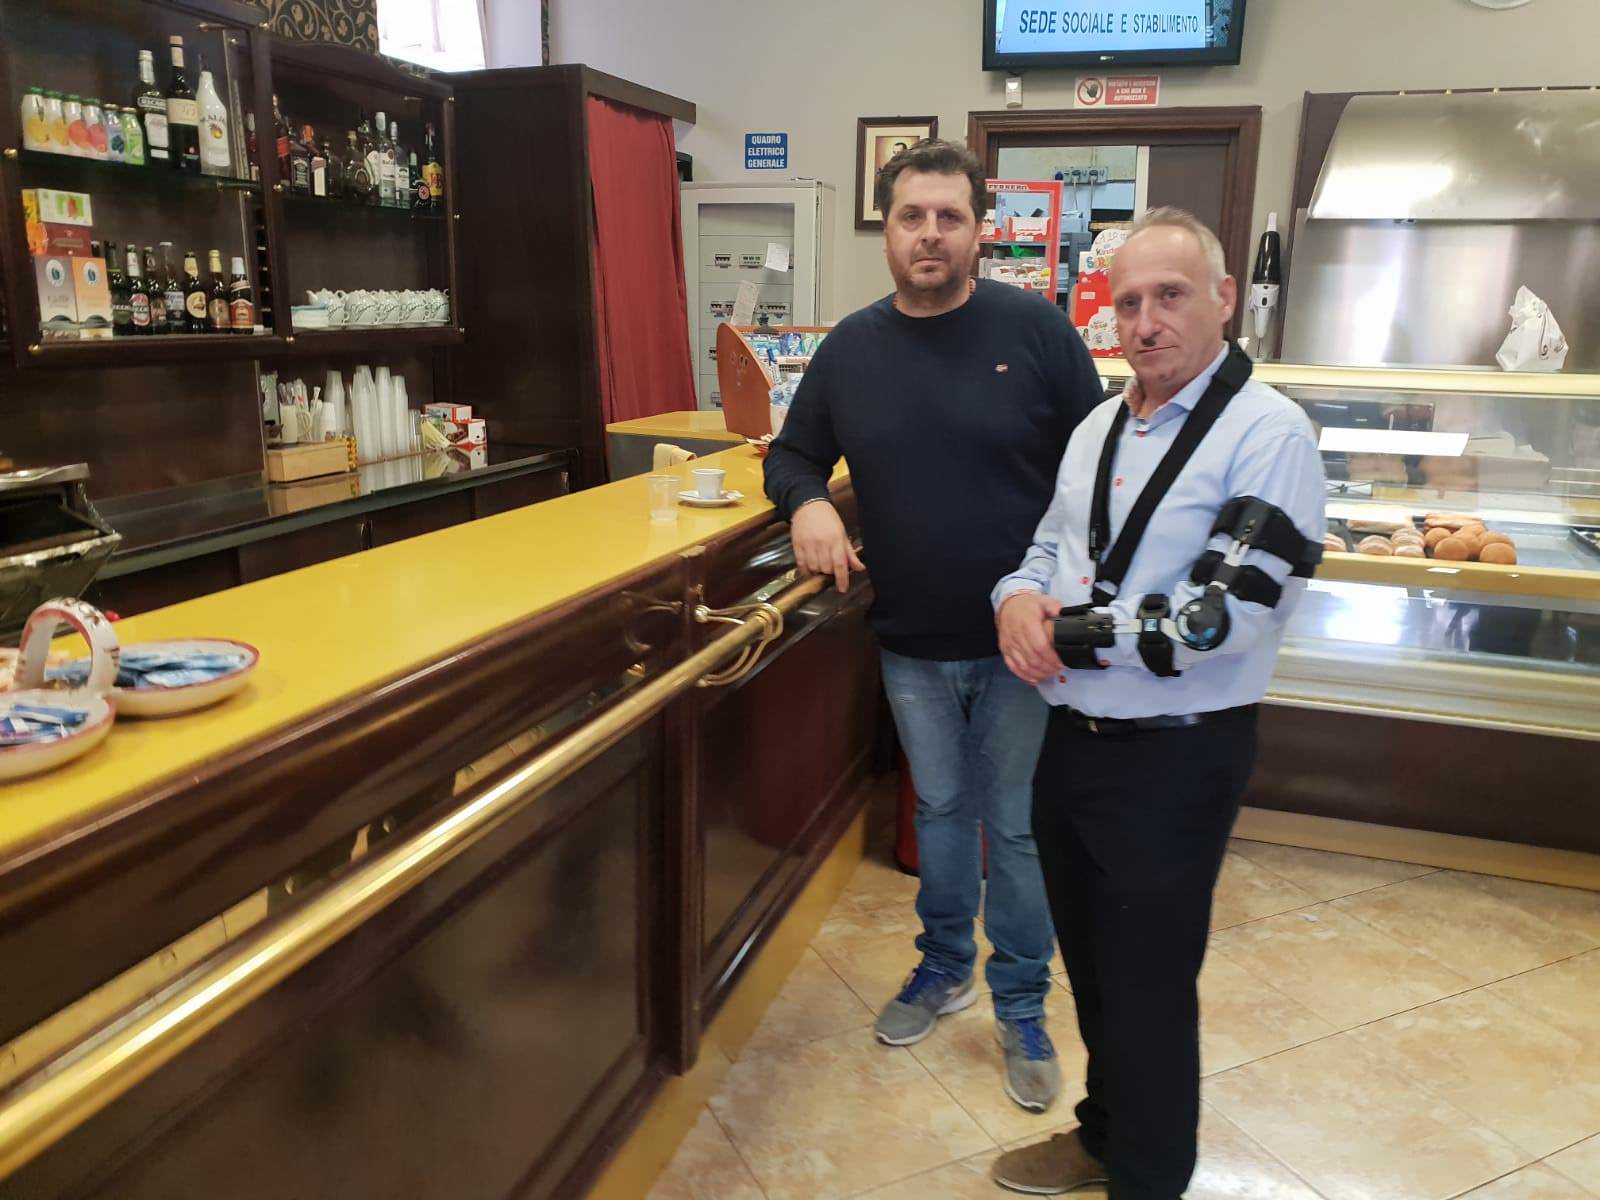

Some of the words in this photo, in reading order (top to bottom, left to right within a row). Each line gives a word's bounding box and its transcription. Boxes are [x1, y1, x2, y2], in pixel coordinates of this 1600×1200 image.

[1019, 9, 1057, 34] SEDE
[1062, 11, 1114, 34] SOCIALE
[1121, 13, 1128, 33] E
[1133, 13, 1198, 33] STABILIMENTO
[751, 135, 782, 144] QUADRO
[747, 147, 785, 156] ELETTRICO
[747, 159, 785, 168] GENERALE
